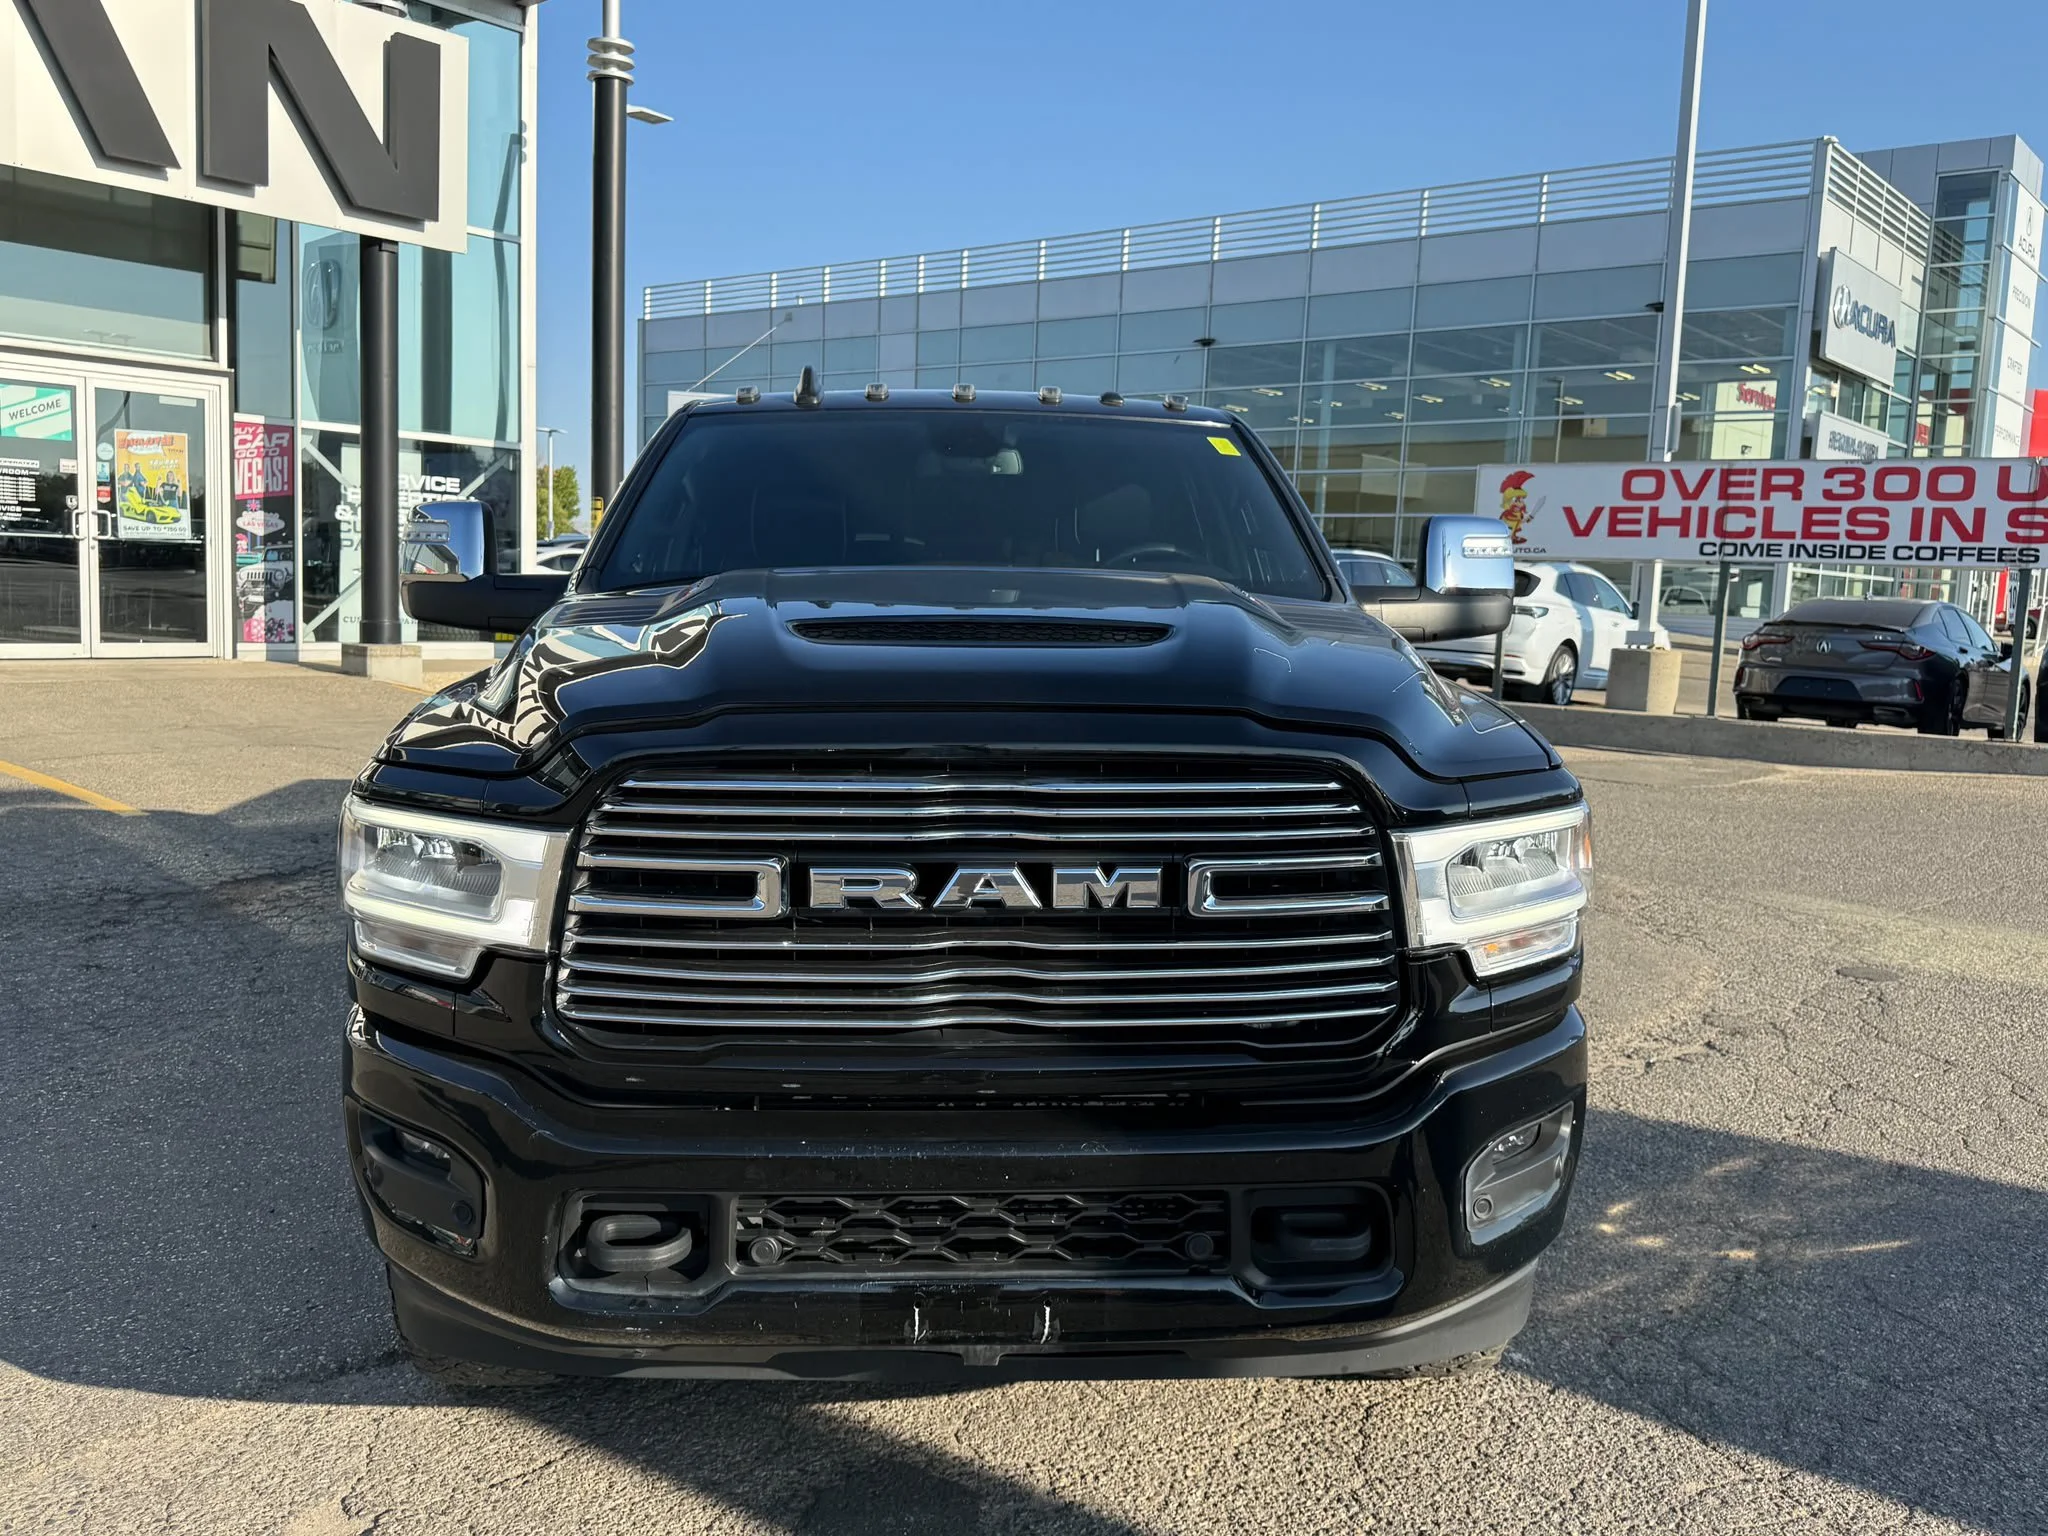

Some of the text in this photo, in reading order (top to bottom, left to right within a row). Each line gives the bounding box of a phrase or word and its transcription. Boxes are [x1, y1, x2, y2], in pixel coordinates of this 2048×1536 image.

[1850, 299, 1896, 348] ACURA
[8, 398, 62, 421] WELCOME
[233, 432, 290, 450] CAR
[234, 426, 255, 435] BUY
[235, 447, 279, 458] GO TO
[234, 455, 289, 495] VEGAS!
[1621, 467, 1805, 501] OVER
[1822, 466, 1977, 501] 300
[1562, 506, 2048, 544] VEHICLES IN S
[1699, 542, 2040, 563] COME INSIDE COFFEES
[809, 864, 1164, 911] RAM
